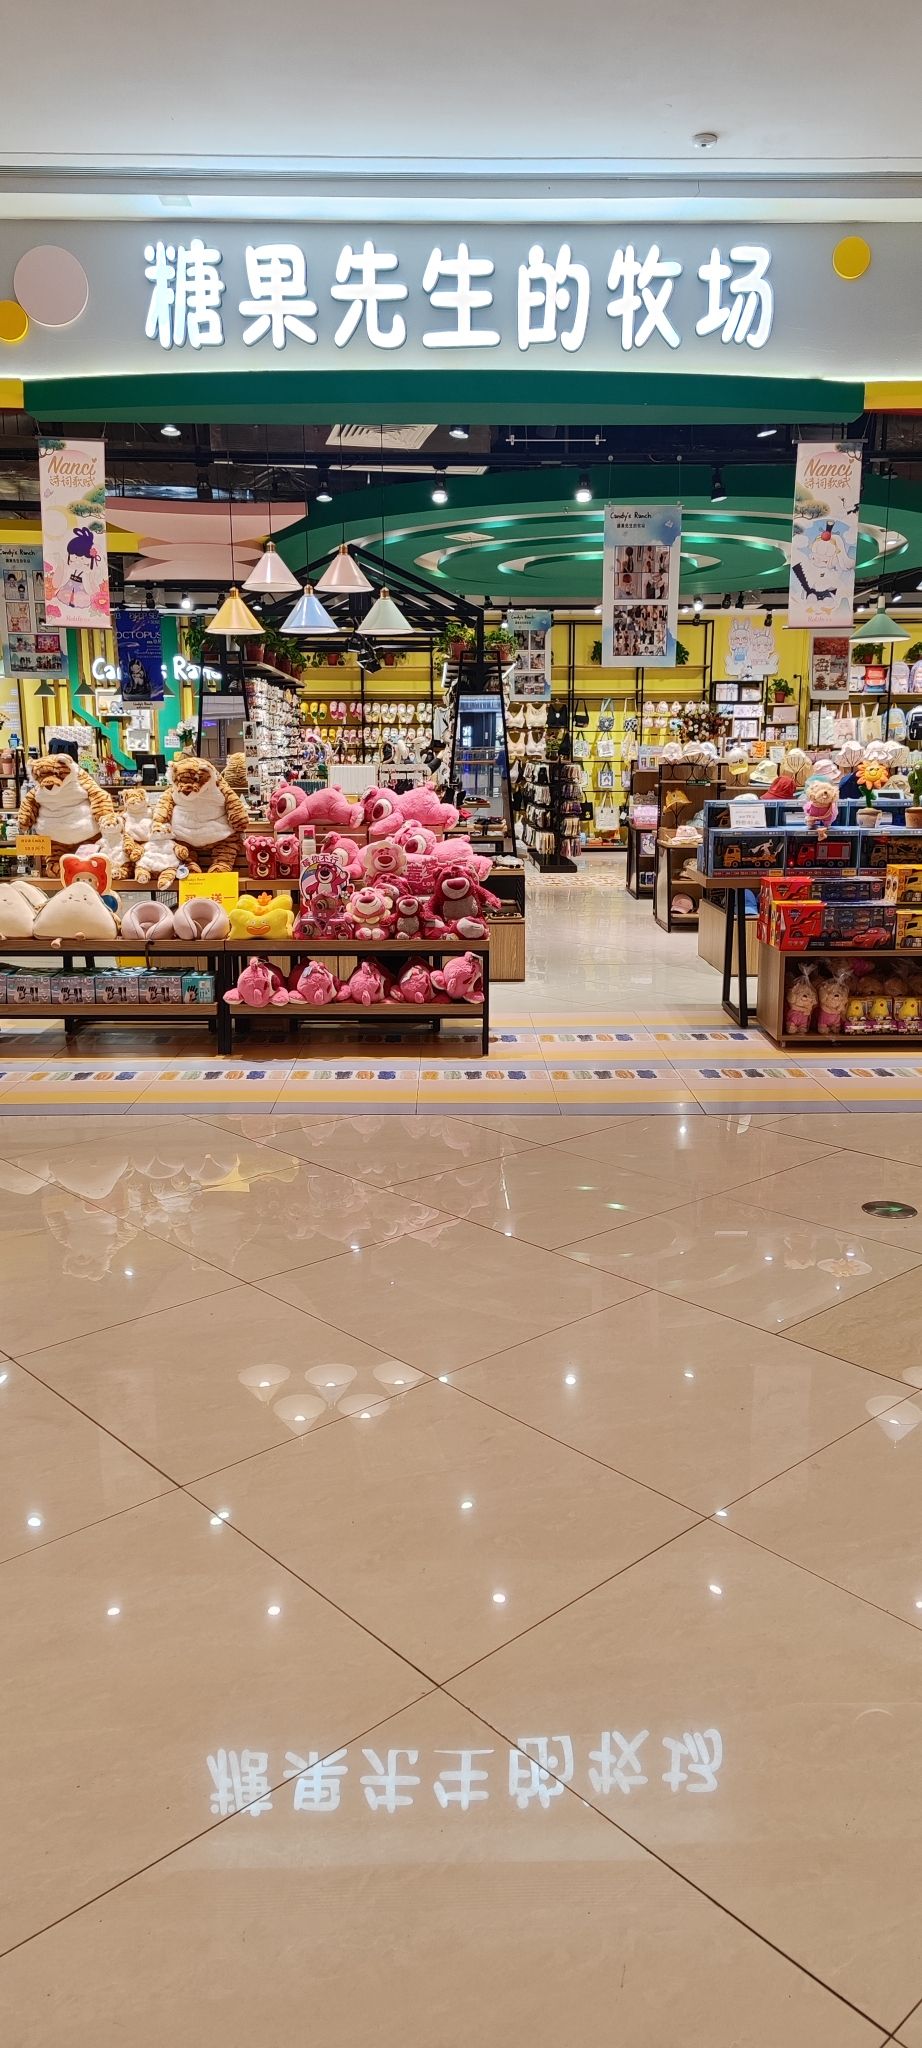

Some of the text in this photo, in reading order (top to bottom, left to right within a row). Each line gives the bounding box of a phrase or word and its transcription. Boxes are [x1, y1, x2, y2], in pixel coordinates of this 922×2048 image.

[143, 239, 779, 350] 糖果先生的牧场
[48, 456, 97, 477] Nanci
[804, 458, 854, 478] Nanci
[50, 475, 96, 487] 诗词歌赋
[805, 477, 851, 489] 诗词歌赋
[634, 511, 652, 519] Ranch
